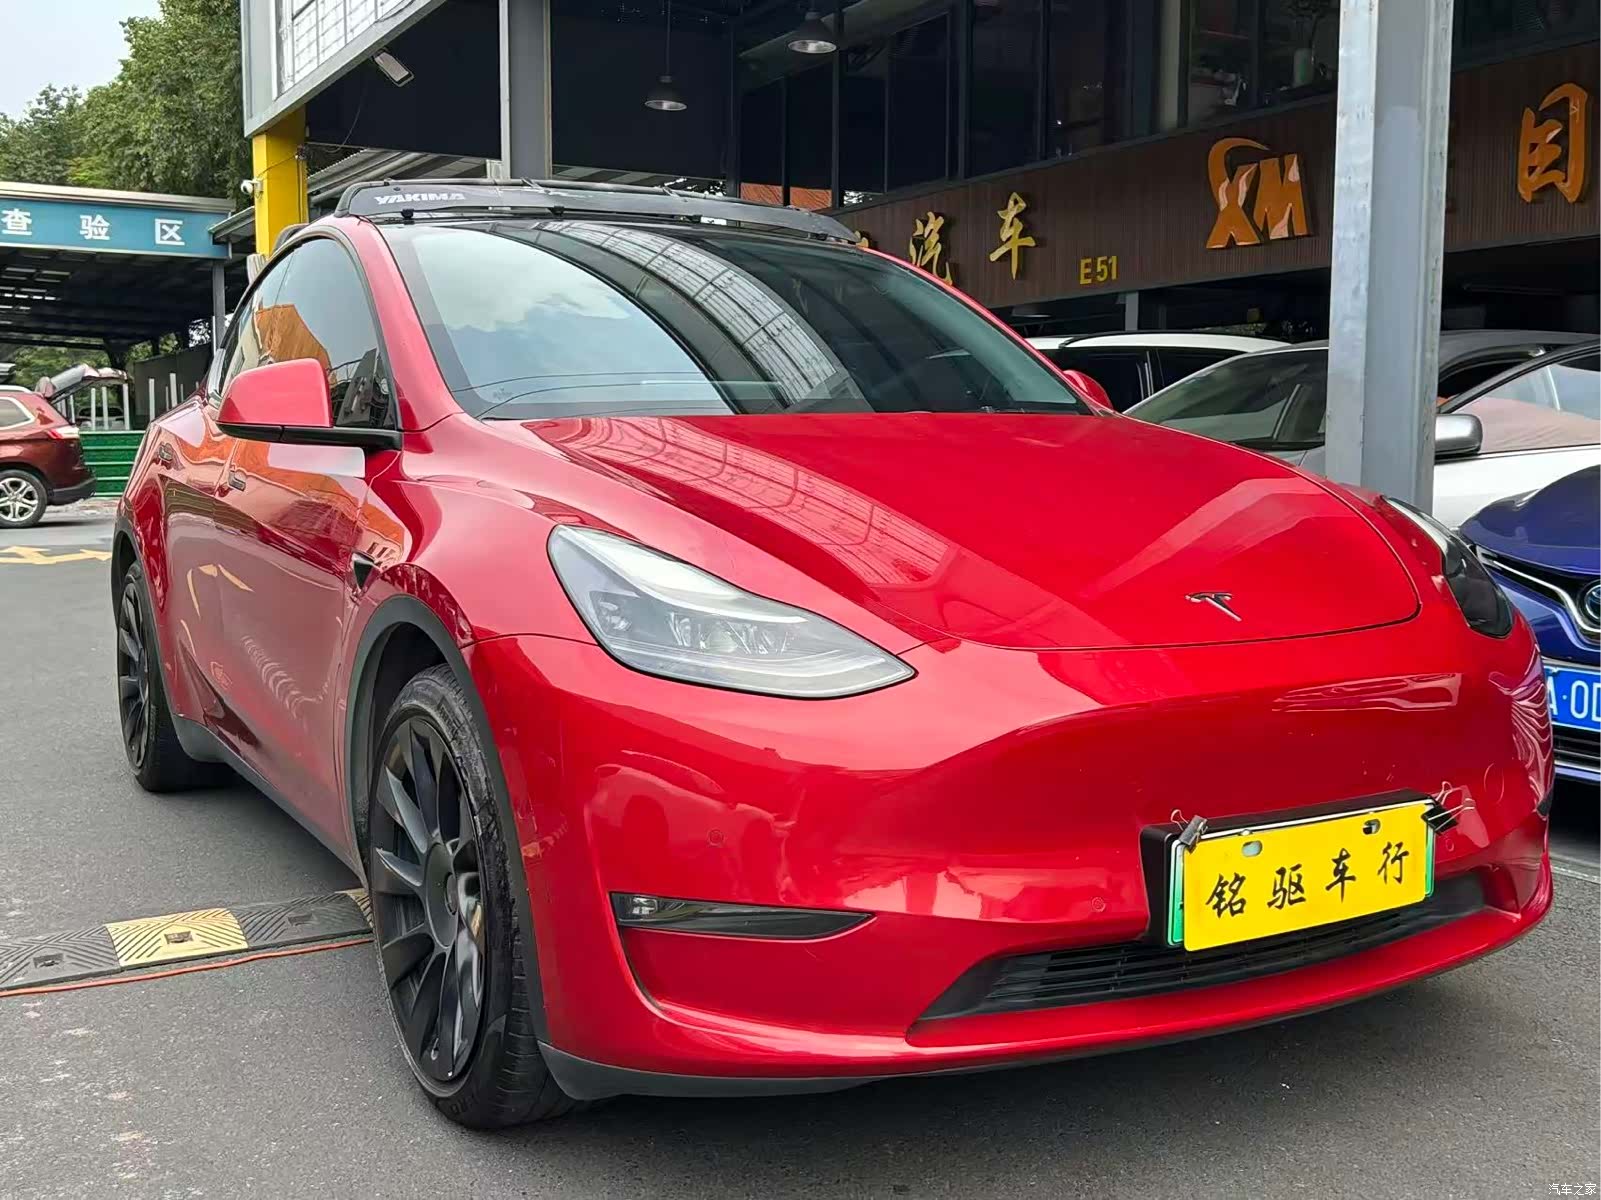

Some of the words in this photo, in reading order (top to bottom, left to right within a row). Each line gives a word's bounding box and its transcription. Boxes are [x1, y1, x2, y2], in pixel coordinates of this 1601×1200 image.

[1, 208, 186, 246] 查验区
[374, 192, 466, 205] YAKIMA
[856, 191, 1036, 286] 汽车
[1205, 840, 1410, 919] 铭驱车行
